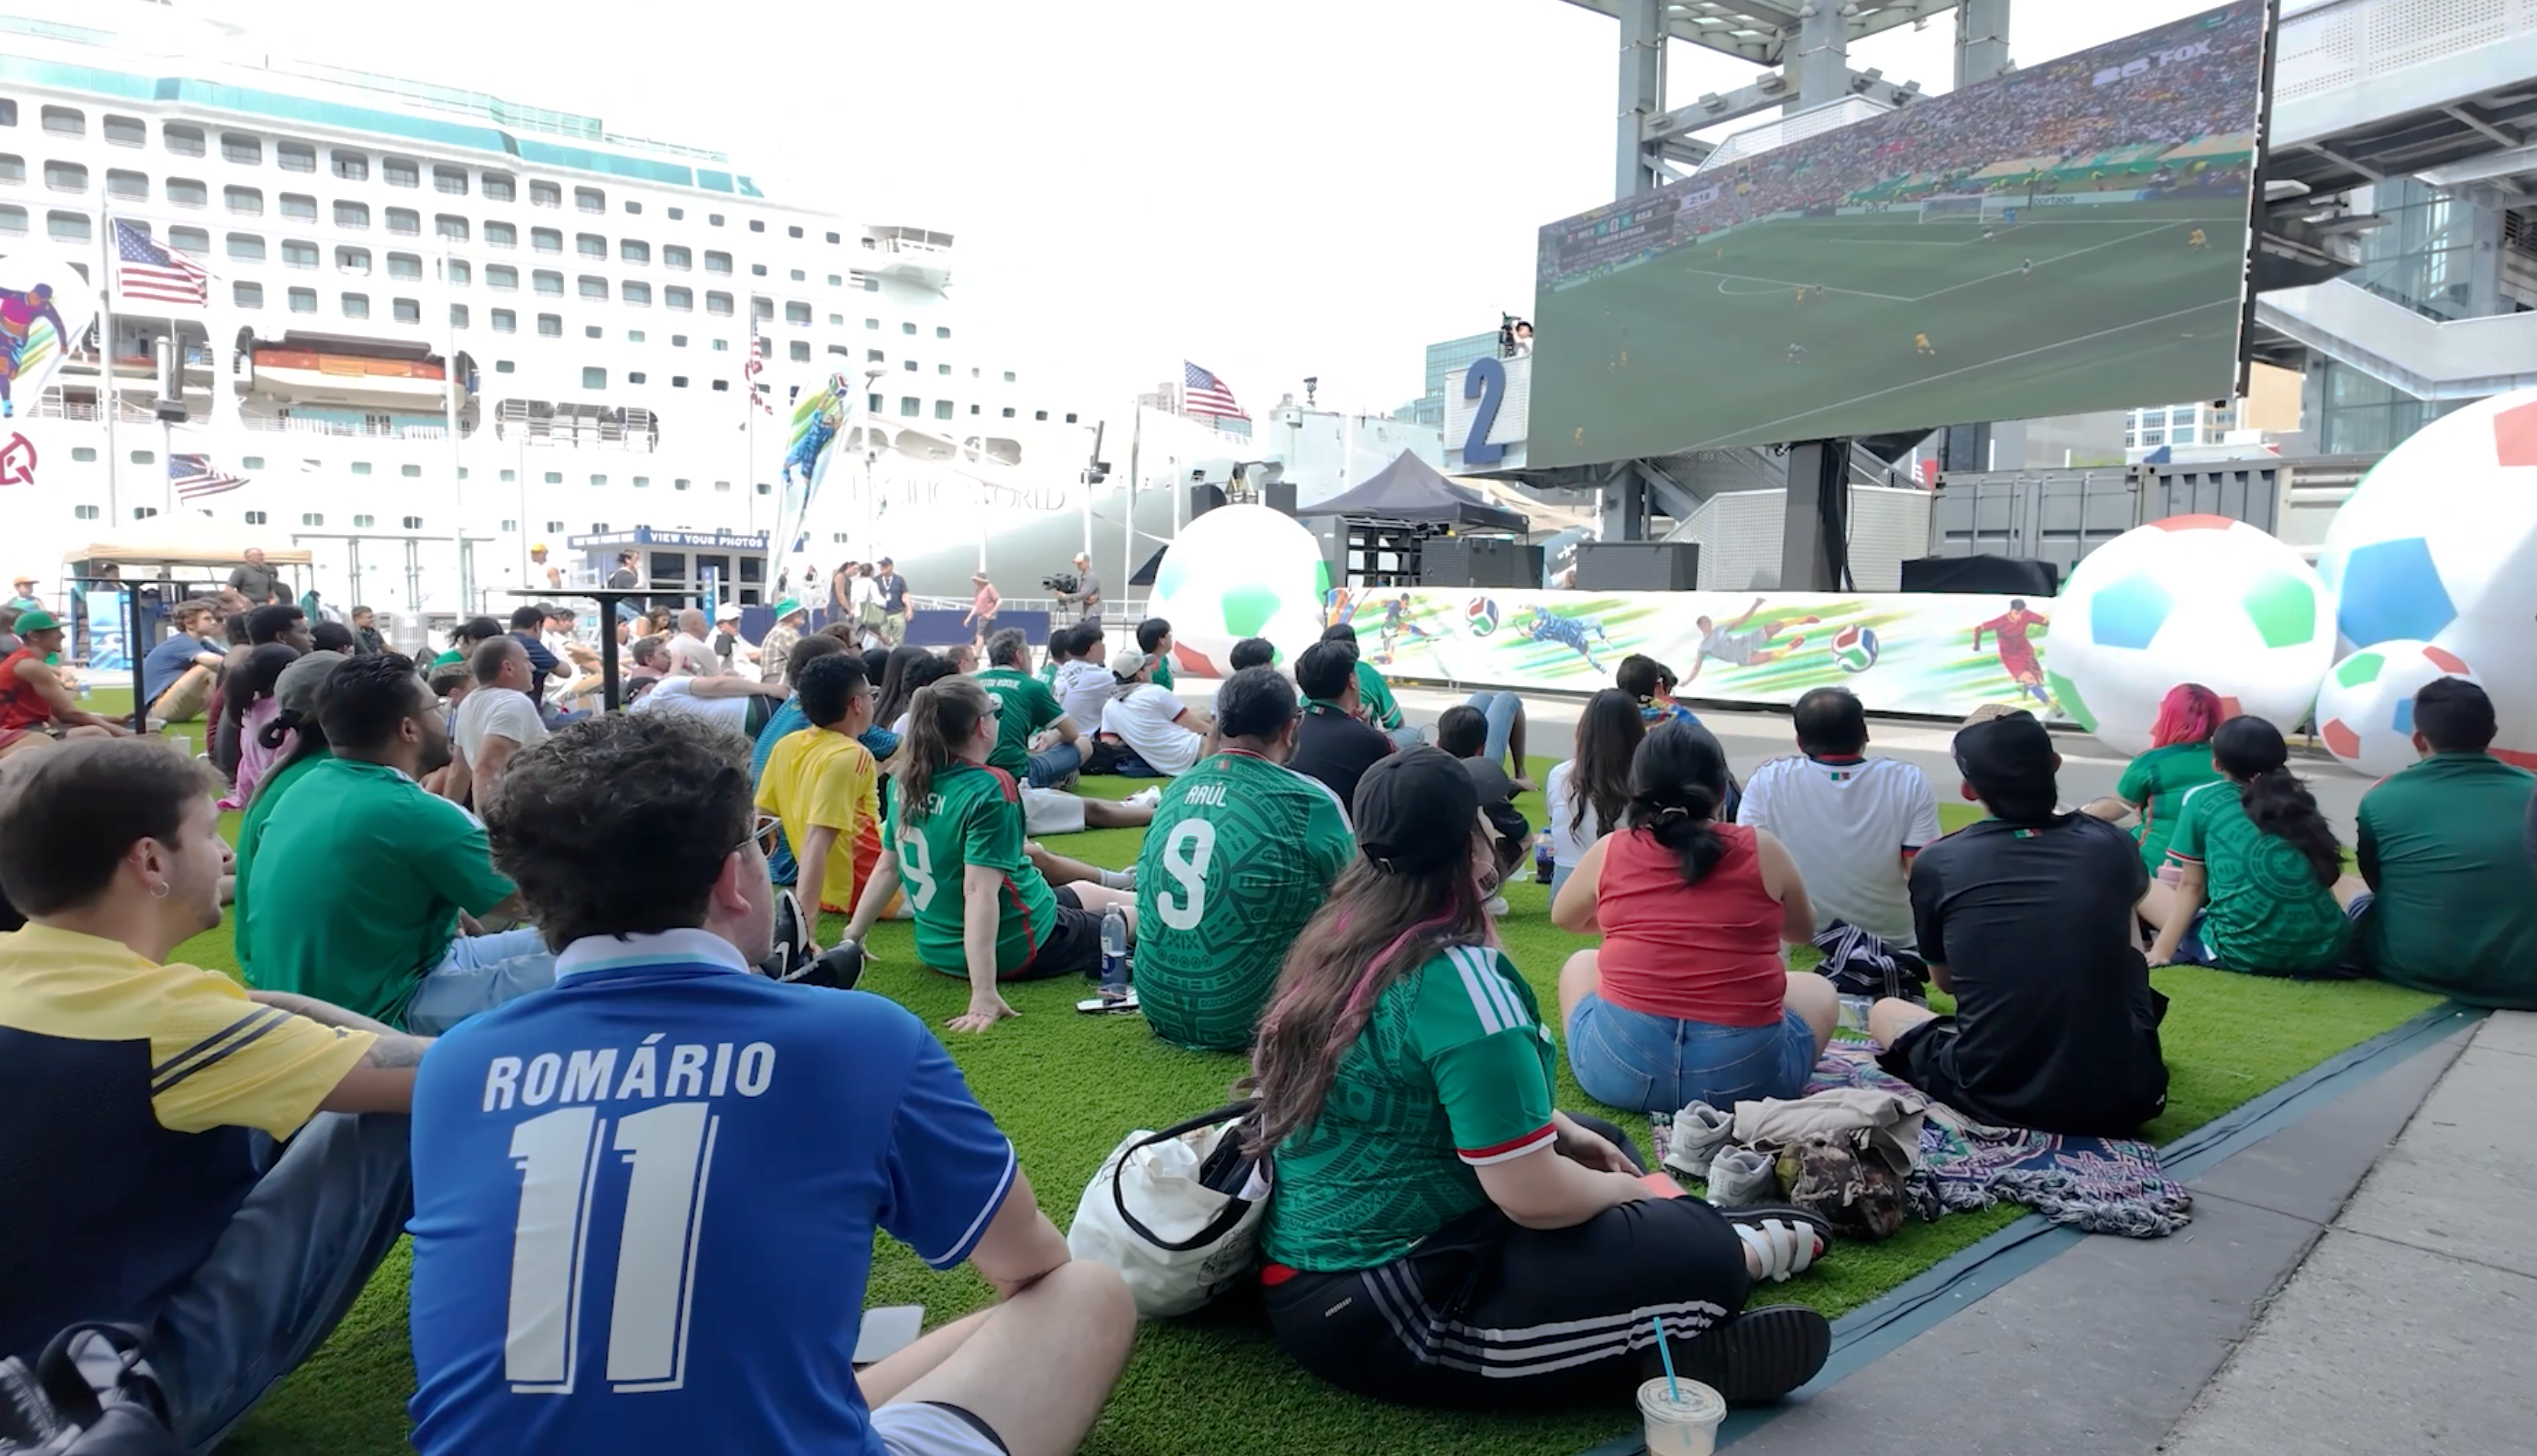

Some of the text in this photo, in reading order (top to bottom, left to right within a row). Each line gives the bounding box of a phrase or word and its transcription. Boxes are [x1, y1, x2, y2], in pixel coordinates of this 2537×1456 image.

[2157, 39, 2211, 67] FOX
[1463, 357, 1506, 465] 2
[650, 532, 680, 544] VIEW
[685, 534, 716, 546] YOUR
[719, 537, 764, 548] PHOTOS
[1184, 781, 1227, 807] RAÚL
[895, 825, 938, 912] 9
[1157, 818, 1216, 931] 9
[483, 1033, 776, 1113] ROMÁRIO
[505, 1102, 720, 1395] 11
